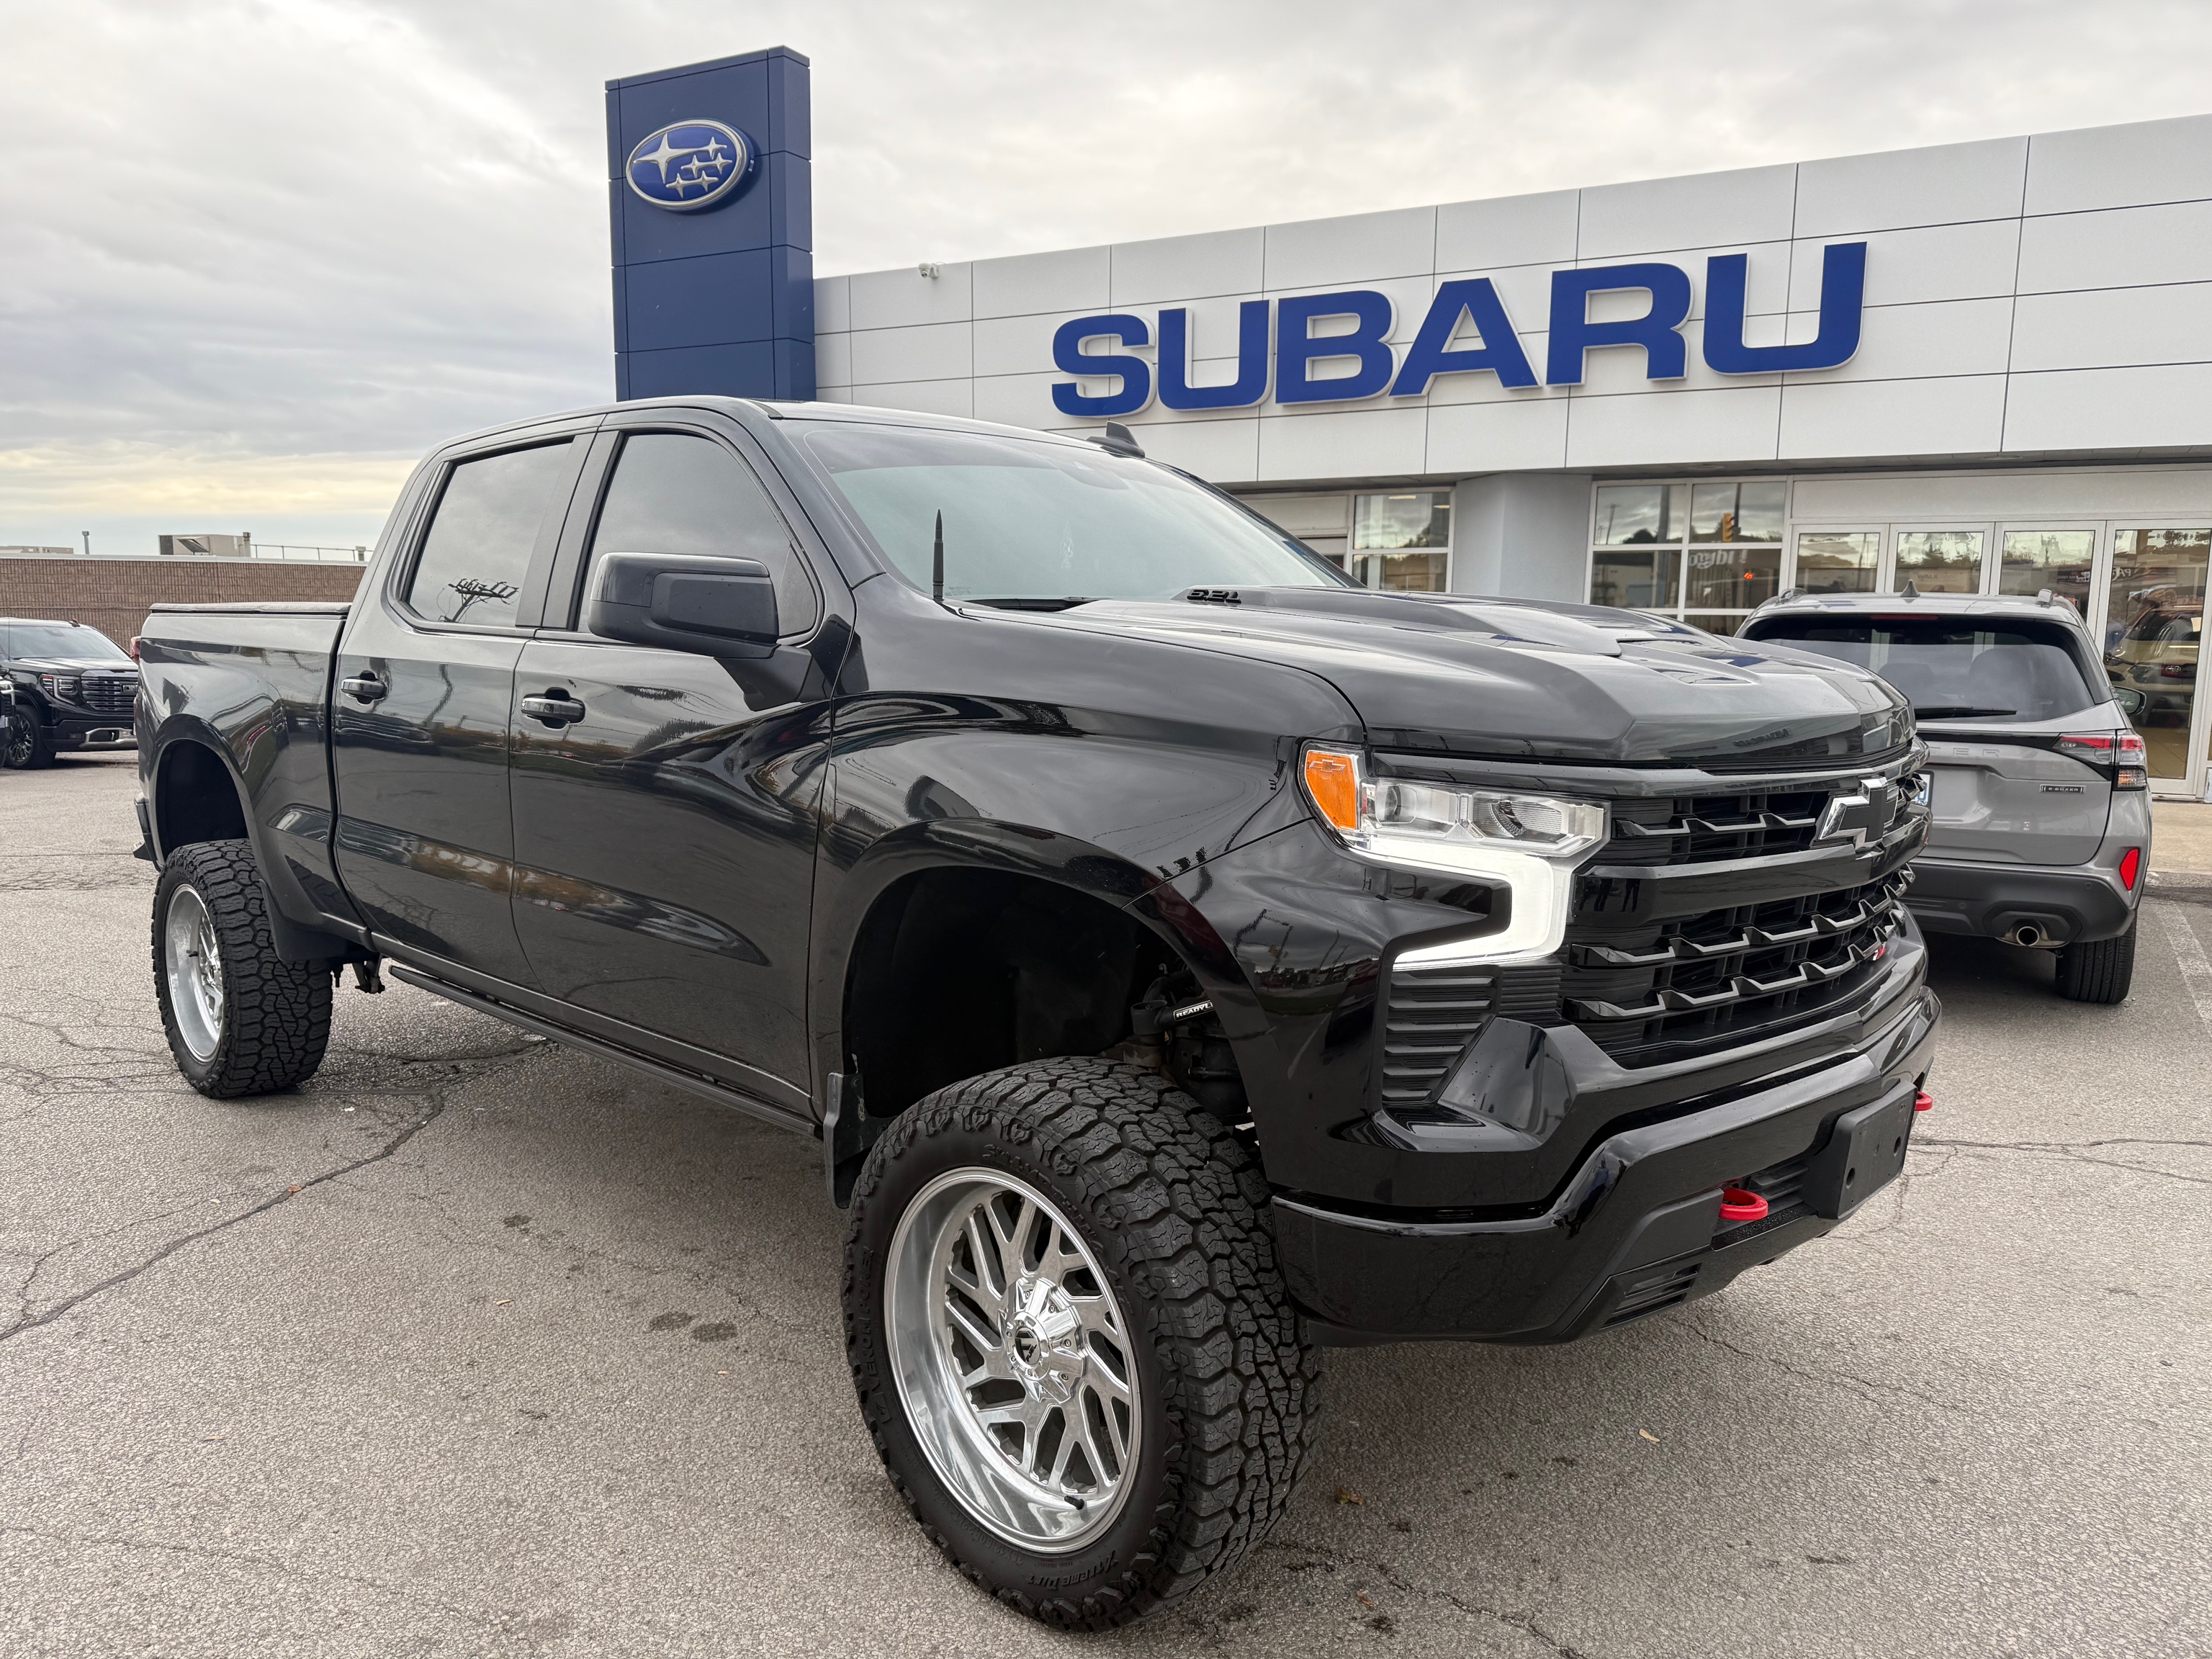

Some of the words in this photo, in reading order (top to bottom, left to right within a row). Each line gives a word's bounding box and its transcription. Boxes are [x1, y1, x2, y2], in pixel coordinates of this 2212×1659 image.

[1051, 241, 1868, 418] SUBARU
[1187, 589, 1241, 603] 6.2L
[858, 1245, 875, 1316] POWER
[858, 1317, 881, 1392] VENOM
[1025, 1344, 1038, 1362] FUEL
